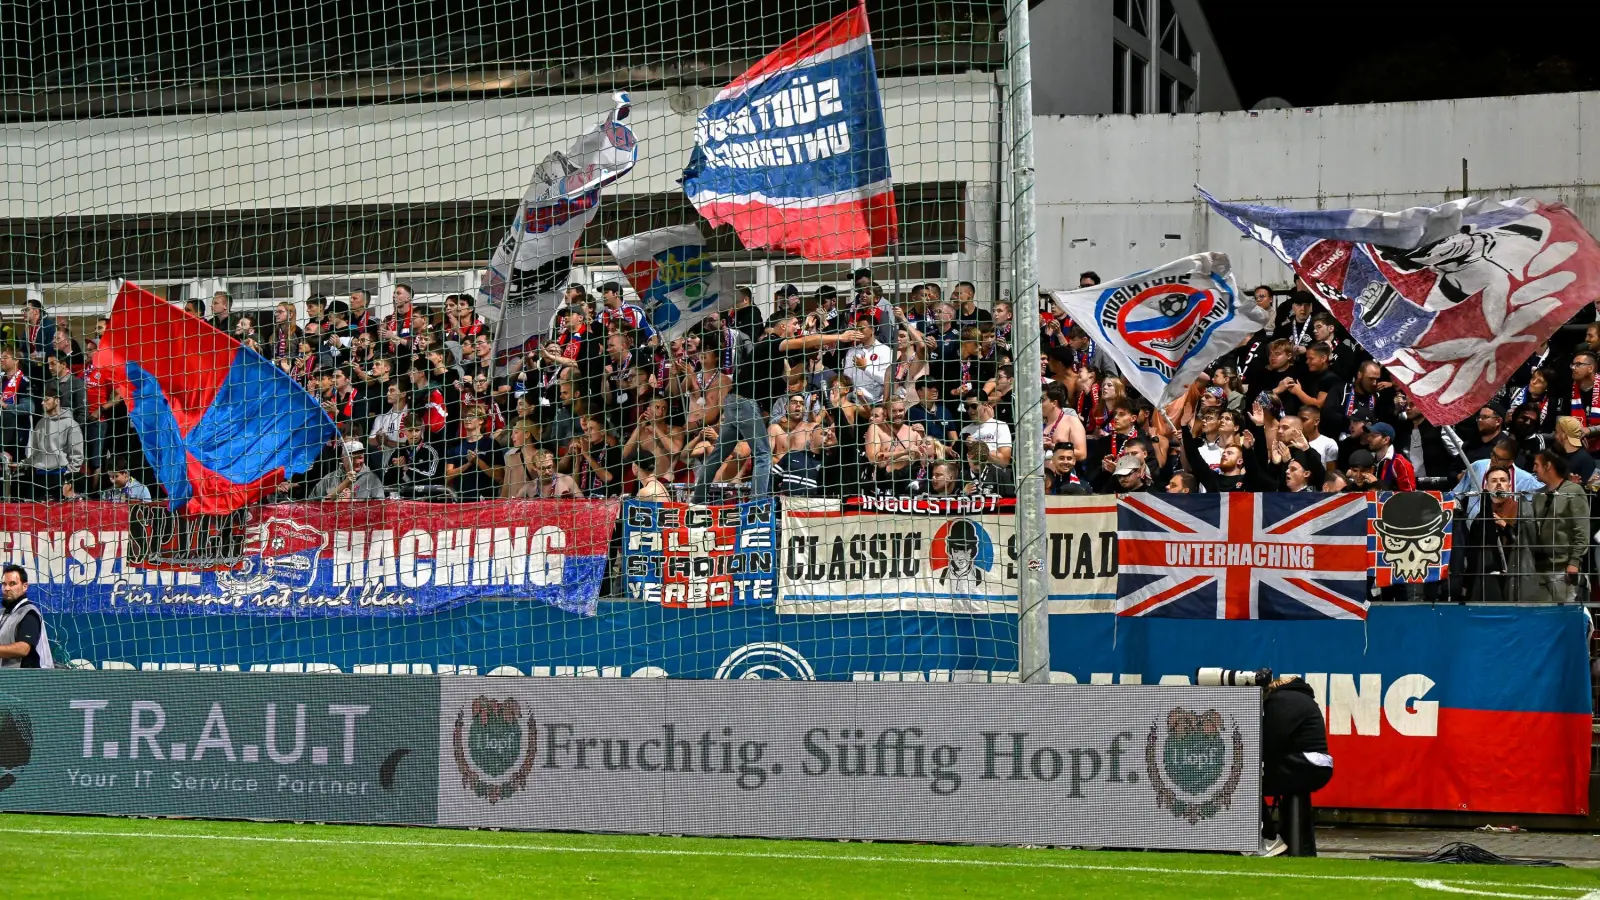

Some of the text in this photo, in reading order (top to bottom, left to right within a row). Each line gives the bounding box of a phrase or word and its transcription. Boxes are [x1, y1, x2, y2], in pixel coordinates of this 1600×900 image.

[627, 502, 772, 528] GEGEN
[862, 494, 999, 514] INGOLSTADT
[627, 527, 773, 553] ALLE
[334, 525, 567, 586] HACHING
[627, 551, 772, 578] STADION
[786, 531, 1119, 581] CLASSIC SUAD
[1165, 542, 1315, 569] UNTERHACHING
[162, 586, 245, 607] immer
[251, 588, 292, 607] rot
[299, 582, 353, 606] und
[359, 581, 413, 606] blau
[627, 577, 774, 606] VERBOTE
[69, 699, 370, 765] T.R.A.U.T
[542, 721, 1139, 799] Fruchtig. Süffig Hopf.
[67, 768, 369, 795] Your IT Service Partner
